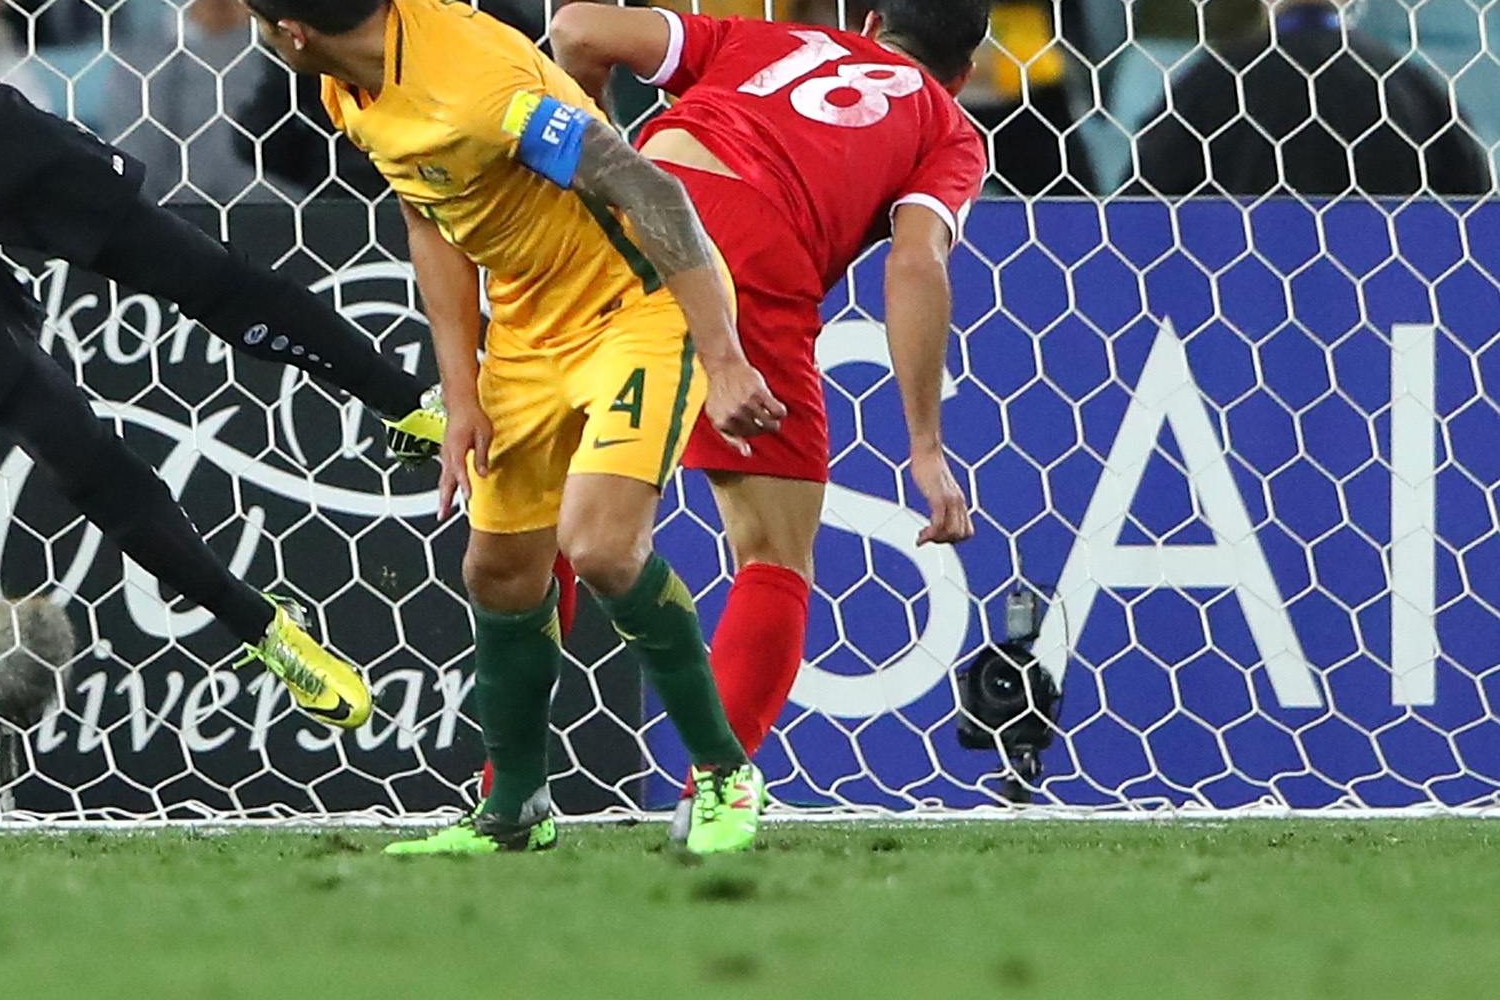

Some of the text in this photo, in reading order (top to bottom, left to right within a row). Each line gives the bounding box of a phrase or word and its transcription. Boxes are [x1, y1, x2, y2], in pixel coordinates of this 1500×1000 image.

[736, 29, 924, 128] 18
[14, 257, 235, 365] kon
[608, 367, 646, 429] 4
